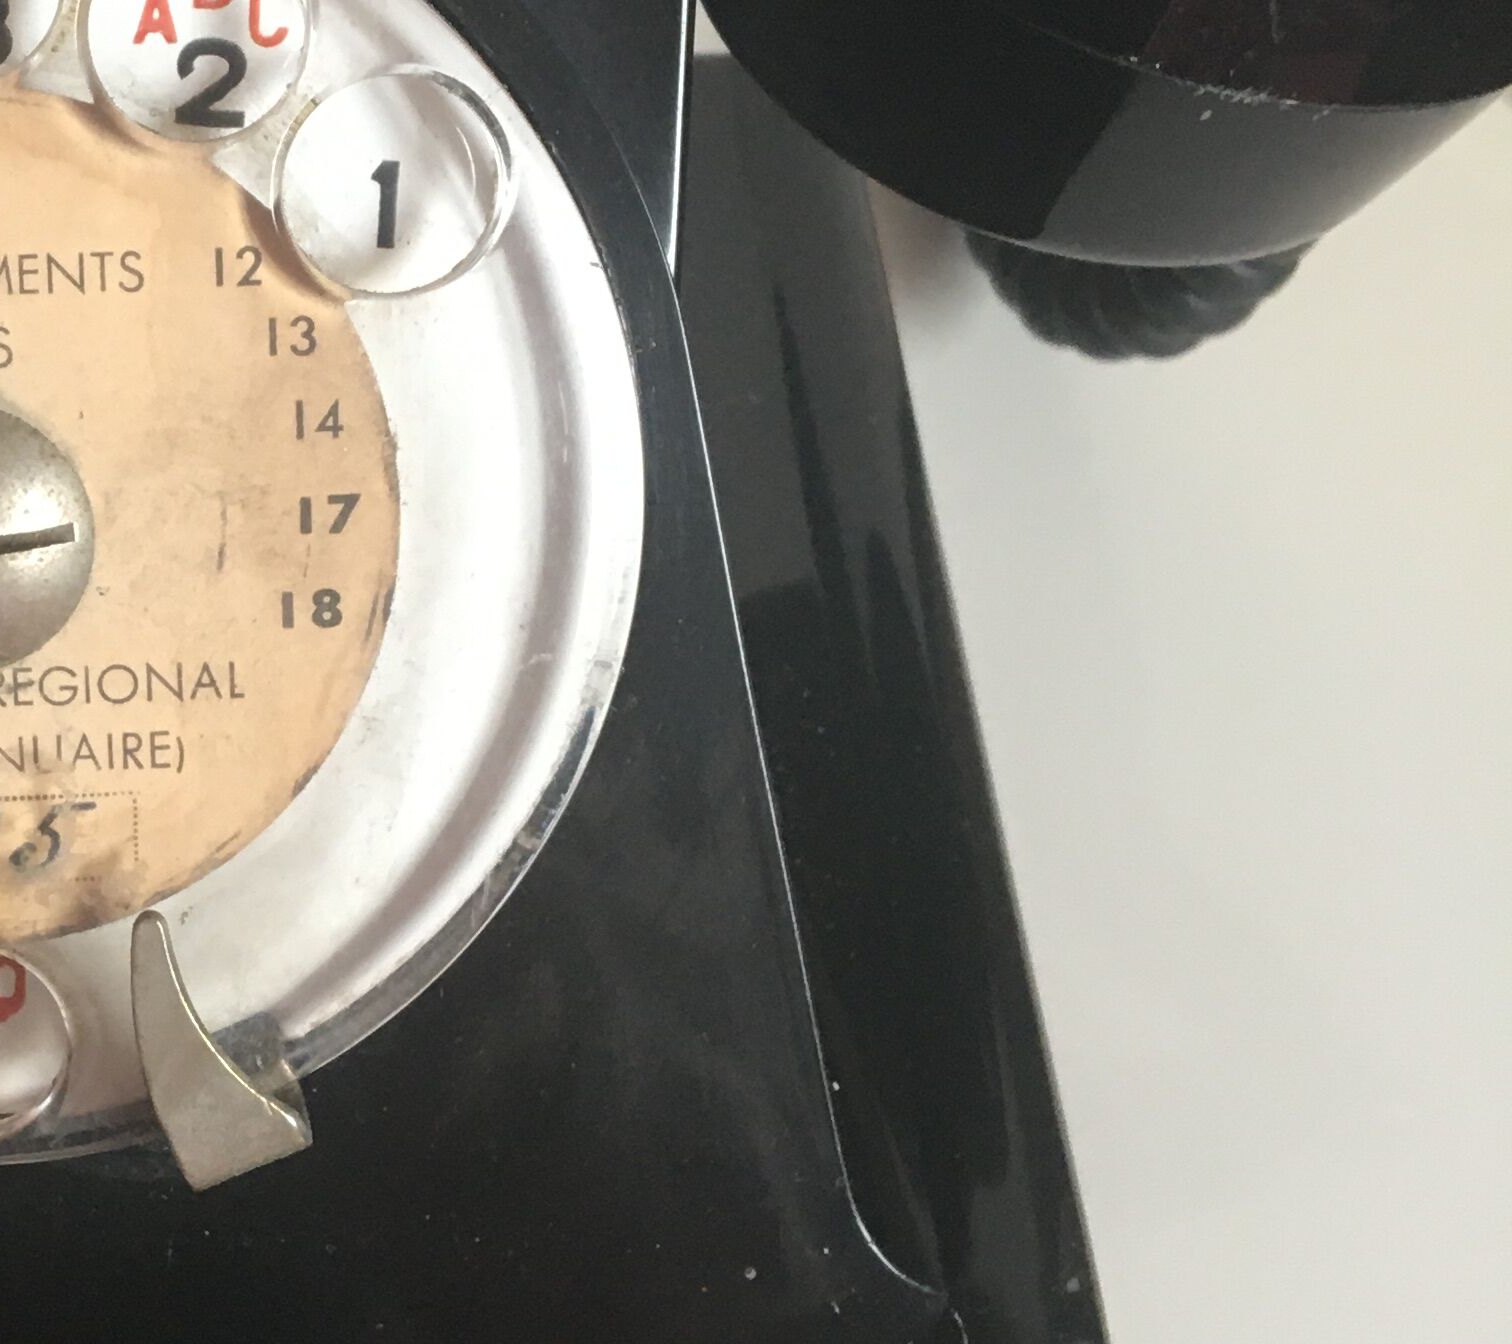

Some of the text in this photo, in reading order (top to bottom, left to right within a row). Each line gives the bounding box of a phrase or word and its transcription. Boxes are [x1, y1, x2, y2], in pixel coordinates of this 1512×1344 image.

[175, 37, 248, 128] 2
[370, 159, 400, 249] 1
[214, 245, 264, 289] 12
[268, 314, 318, 357] 13
[295, 399, 345, 441] 14
[299, 493, 361, 535] 17
[281, 588, 343, 630] 18
